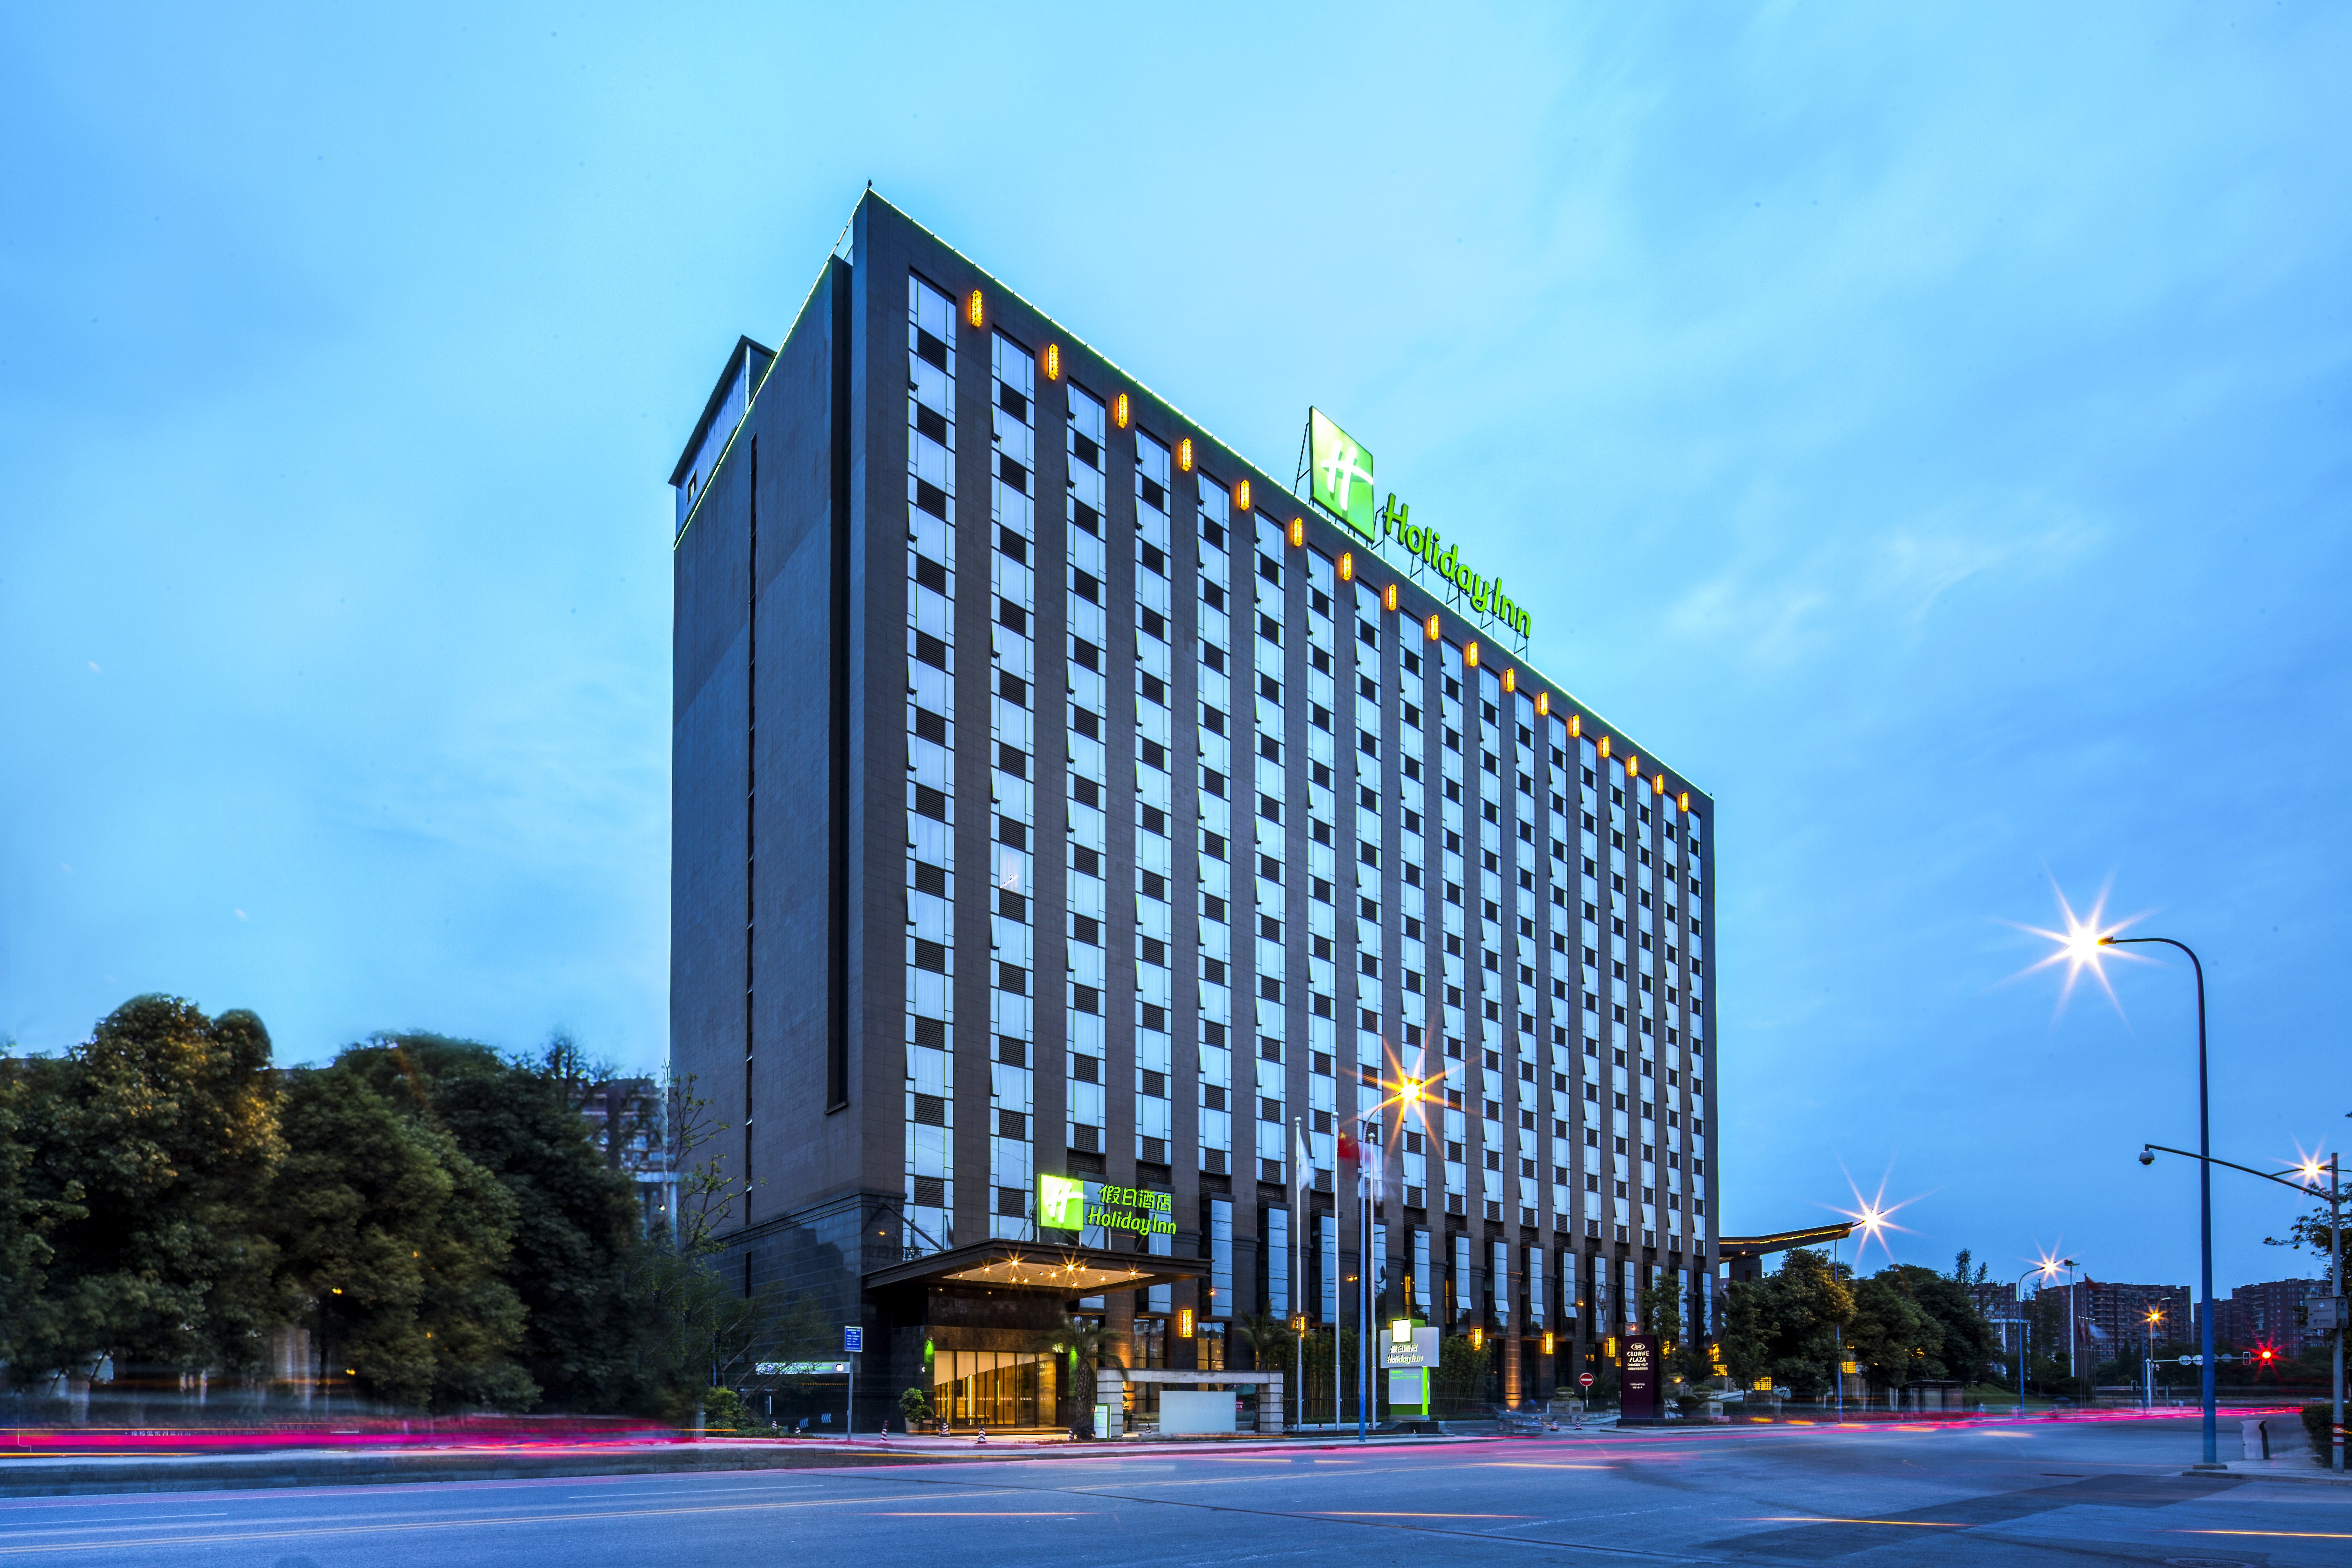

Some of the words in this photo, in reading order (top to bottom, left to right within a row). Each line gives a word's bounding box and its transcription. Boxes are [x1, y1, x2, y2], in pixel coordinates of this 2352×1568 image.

[1383, 492, 1490, 613] Holiday
[1492, 577, 1531, 639] Inn
[1099, 1184, 1172, 1212] 假日酒店
[1087, 1205, 1151, 1236] Holiday
[1152, 1214, 1176, 1235] Inn
